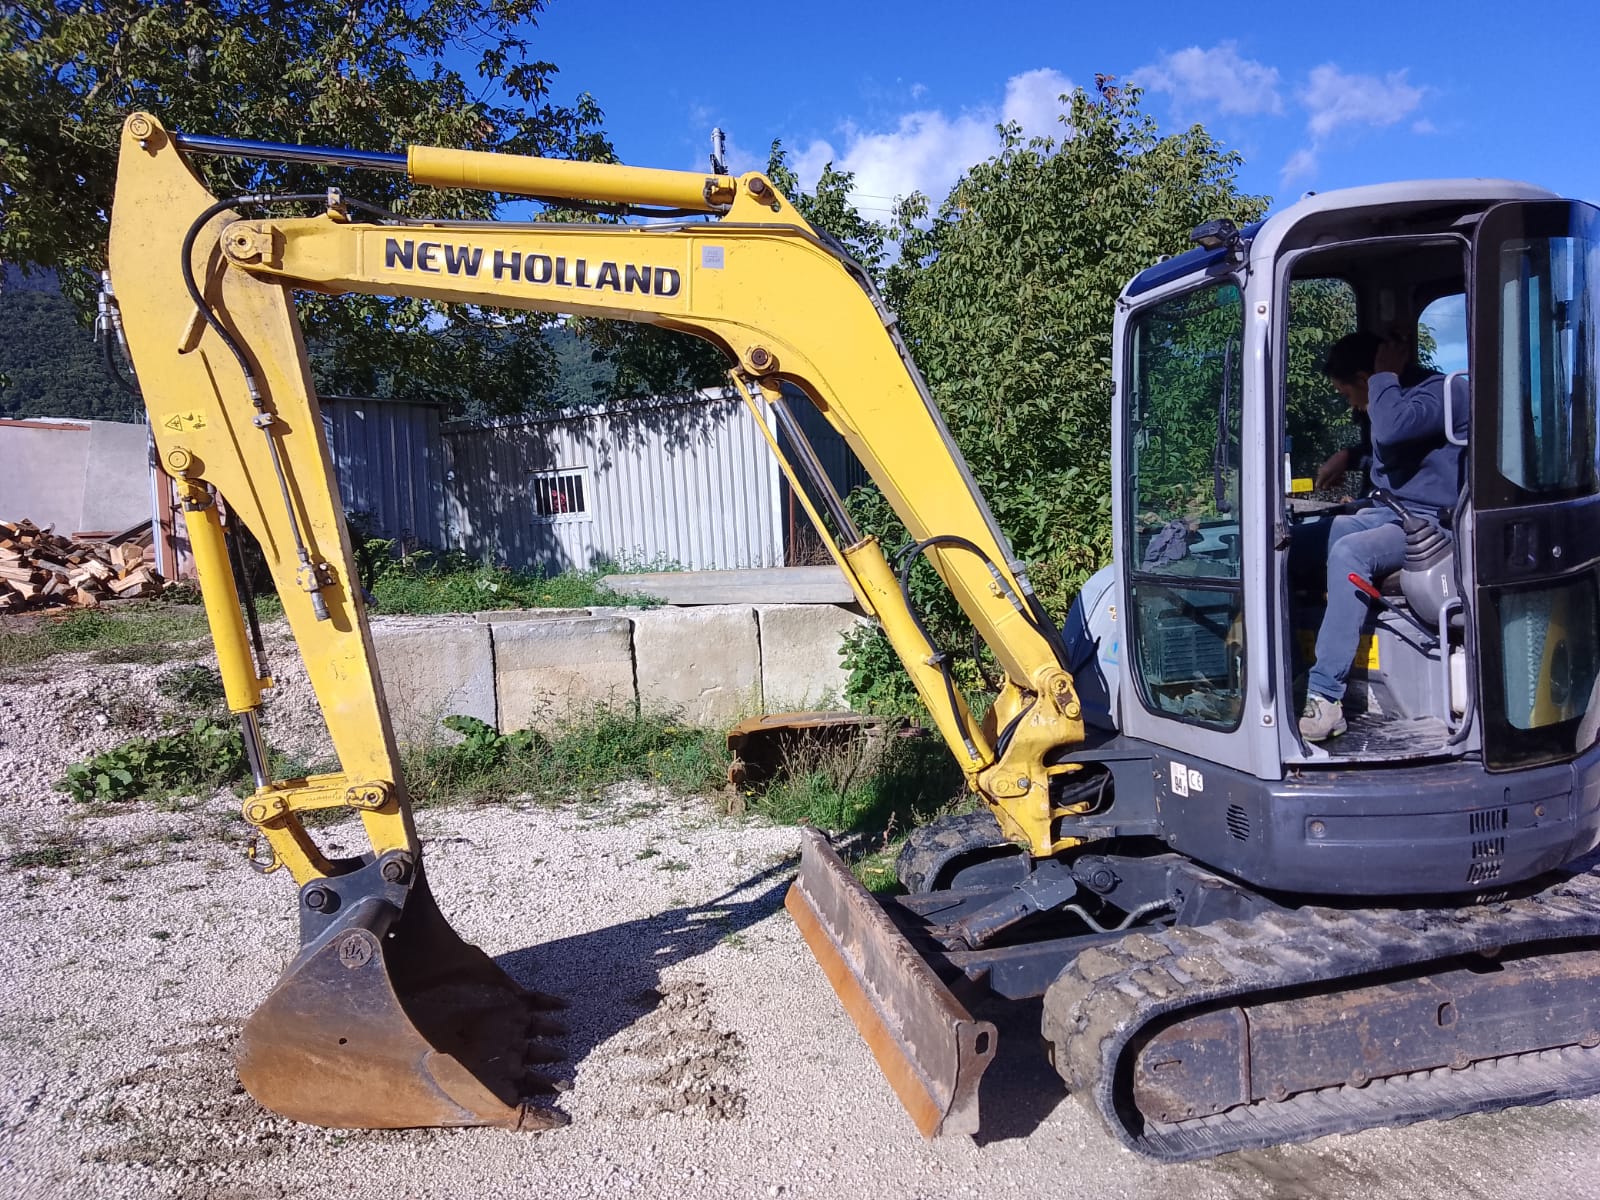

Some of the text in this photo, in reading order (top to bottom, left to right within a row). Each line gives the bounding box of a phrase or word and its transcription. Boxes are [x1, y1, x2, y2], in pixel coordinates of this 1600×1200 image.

[384, 238, 681, 297] NEW HOLLAND
[1190, 772, 1203, 790] CE
